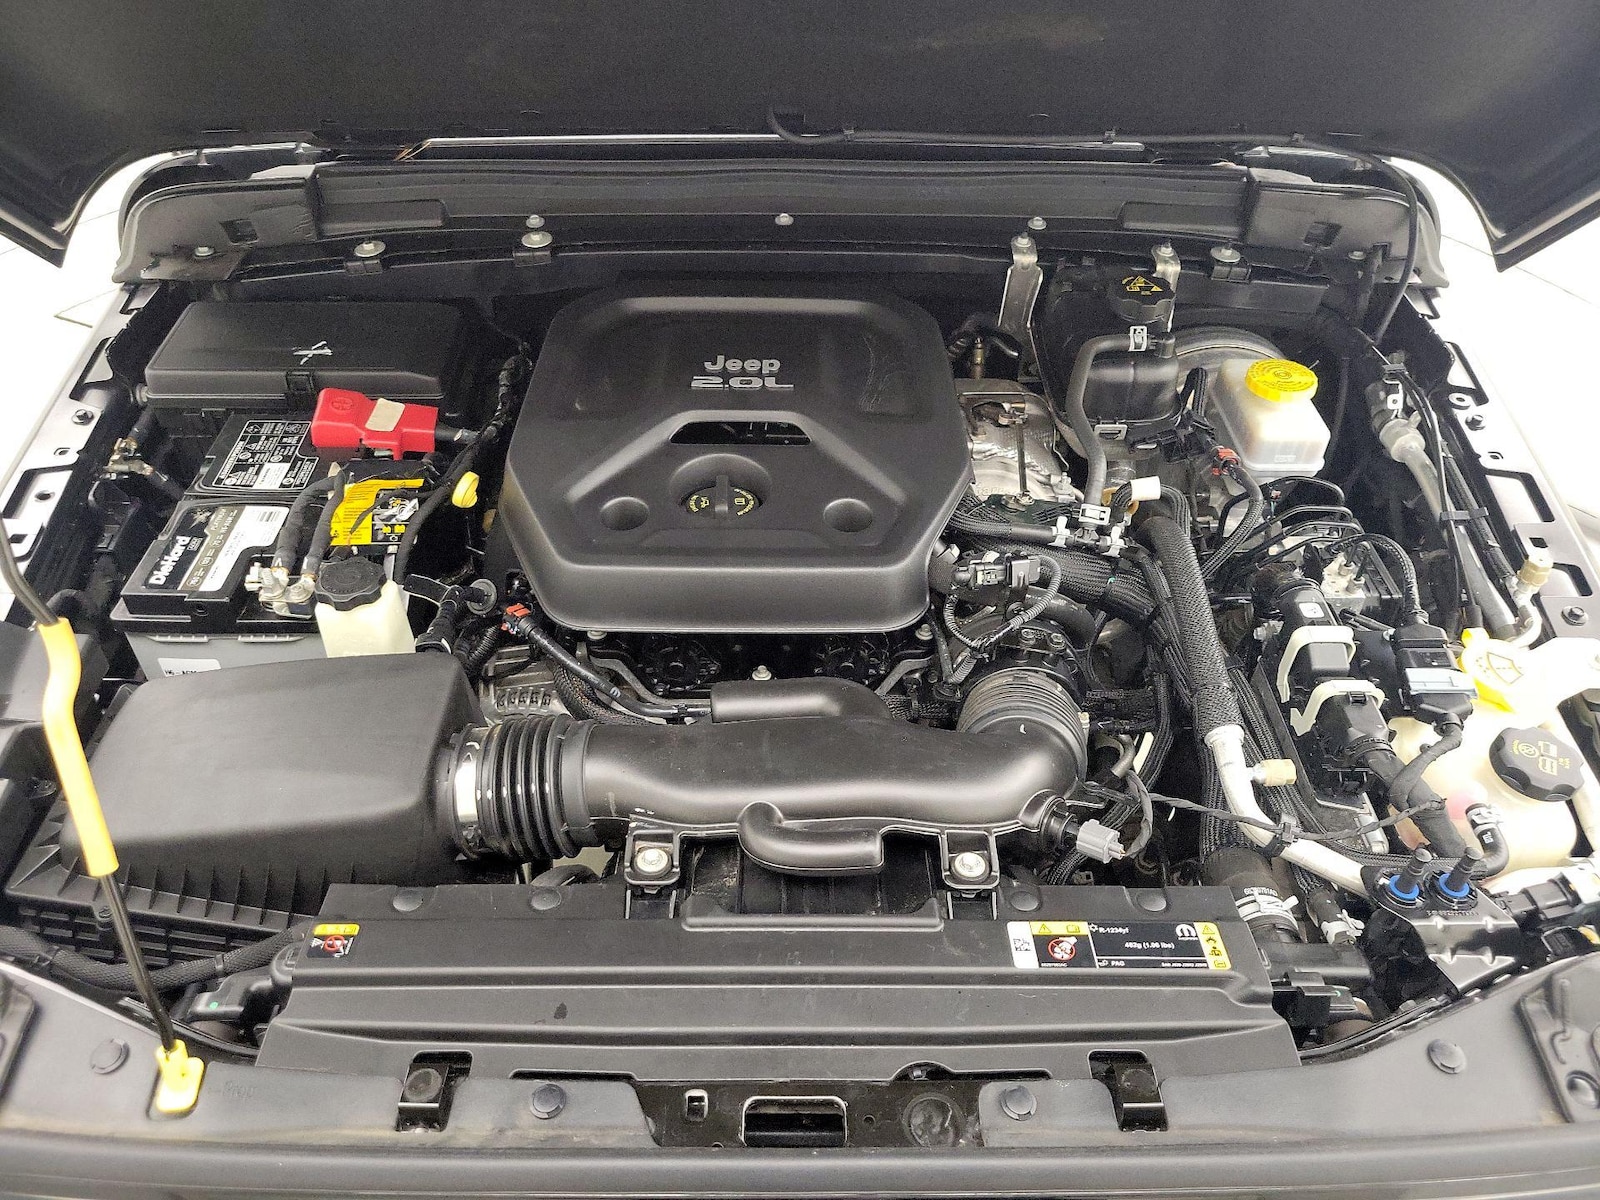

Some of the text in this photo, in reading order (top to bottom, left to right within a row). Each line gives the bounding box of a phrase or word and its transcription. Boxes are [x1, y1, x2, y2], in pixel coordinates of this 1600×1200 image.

[704, 355, 781, 374] Jeep
[691, 376, 795, 391] 2.0L
[149, 535, 192, 586] DieHard
[1099, 926, 1129, 935] R-1234yf
